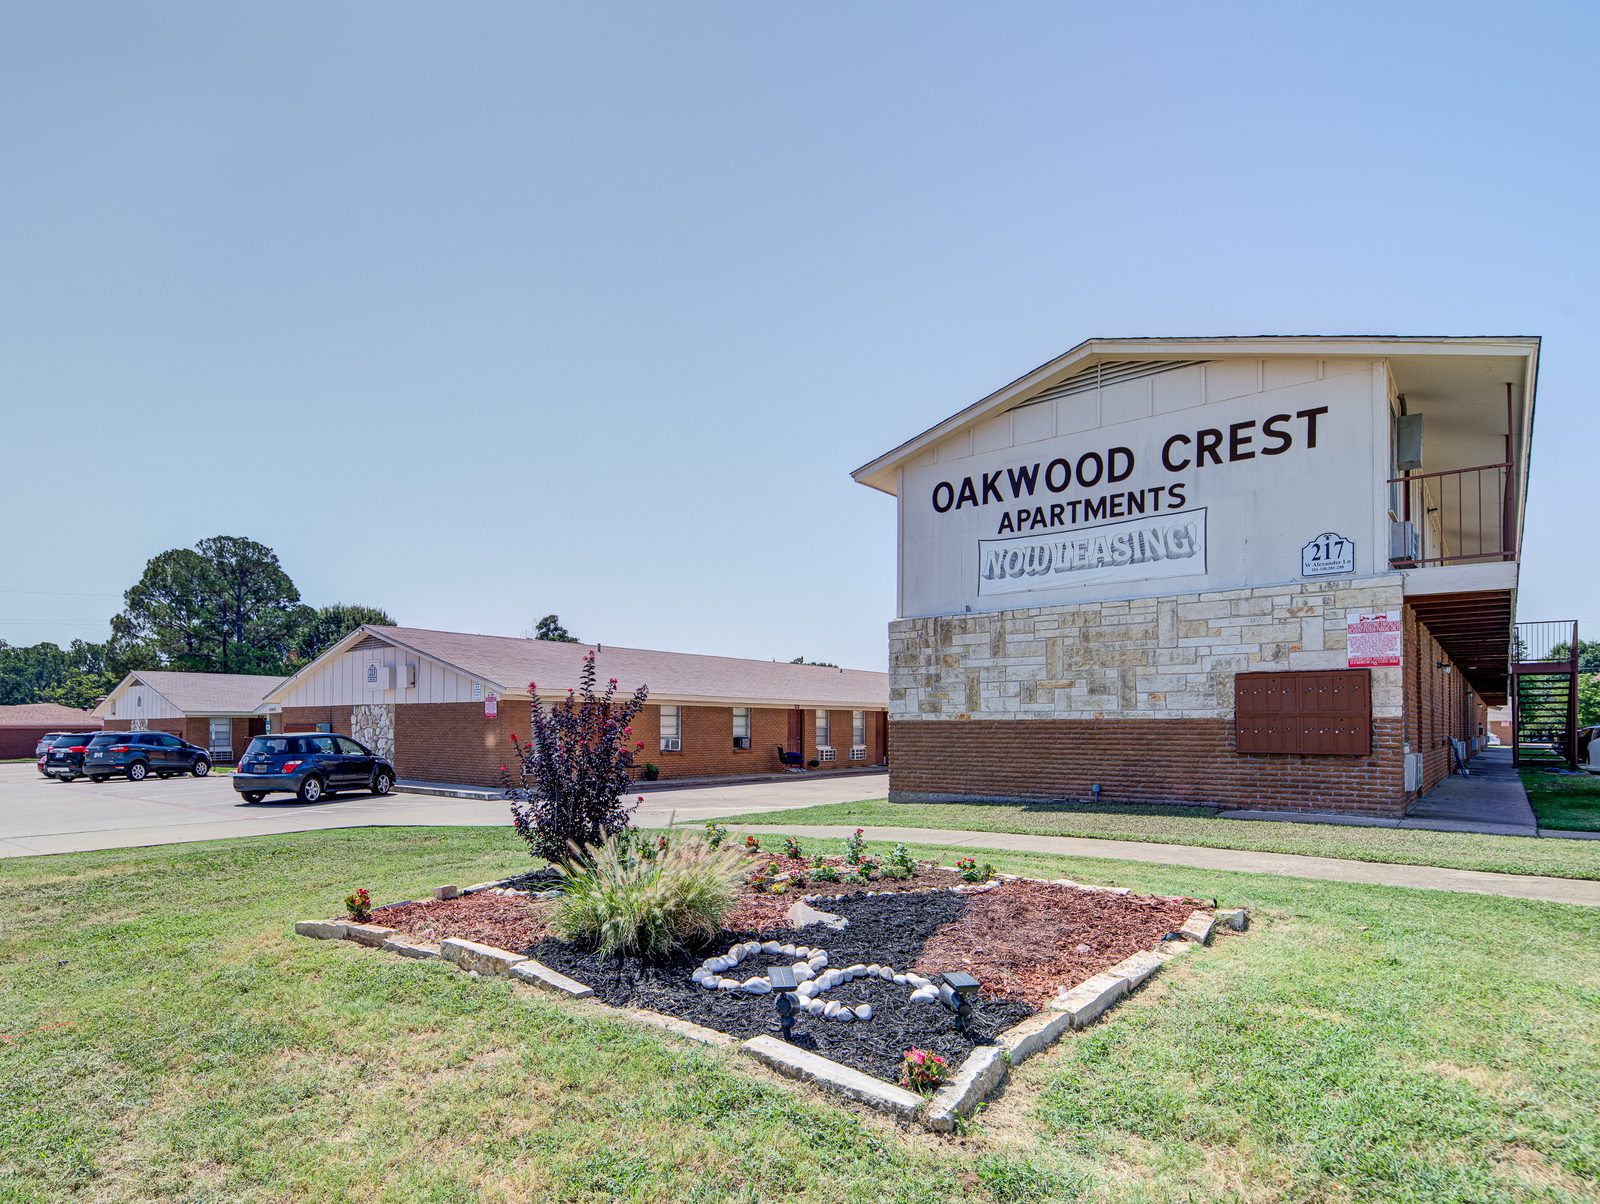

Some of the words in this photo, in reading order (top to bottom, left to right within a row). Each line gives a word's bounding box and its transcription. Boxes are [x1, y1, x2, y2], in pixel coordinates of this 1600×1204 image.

[932, 446, 1135, 513] OAKWOOD
[1161, 405, 1329, 472] CREST
[997, 482, 1187, 535] APARTMENTS
[981, 543, 1053, 581] NOW
[1053, 521, 1202, 574] LEASING!
[1311, 540, 1345, 562] 217
[1312, 559, 1342, 567] Alexander
